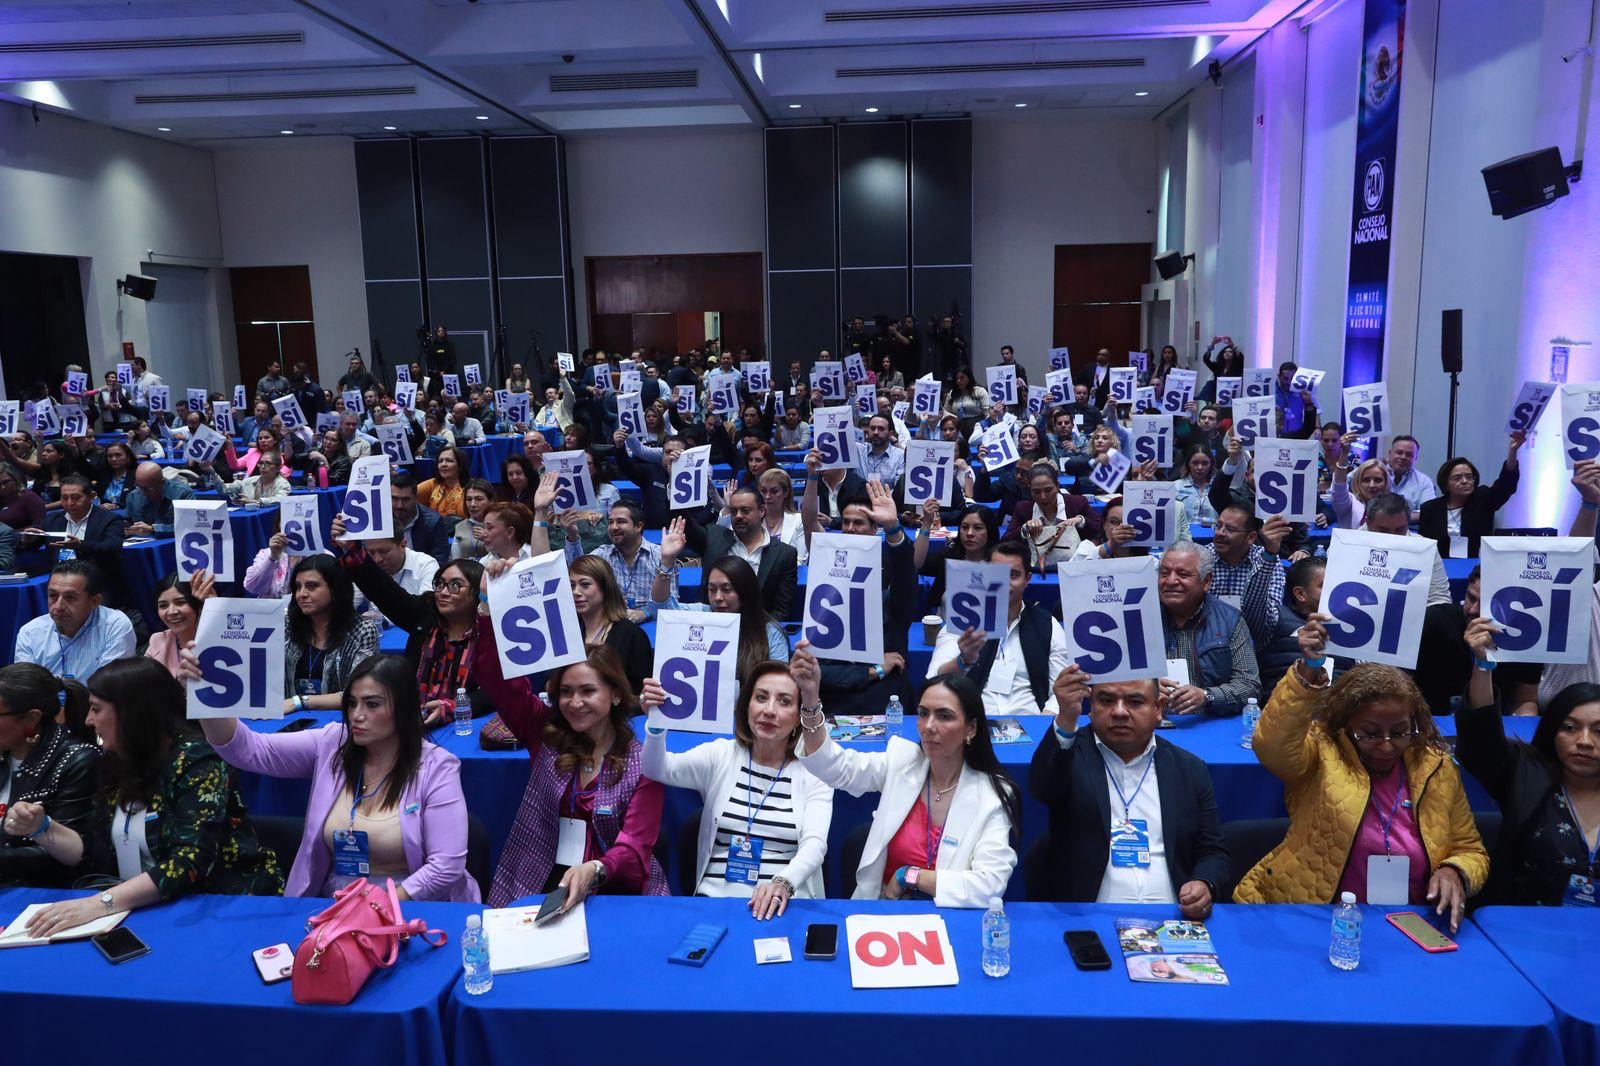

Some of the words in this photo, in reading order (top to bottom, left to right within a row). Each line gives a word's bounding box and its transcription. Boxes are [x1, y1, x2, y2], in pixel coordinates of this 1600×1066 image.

[1358, 214, 1386, 231] CONSEJO
[1354, 225, 1389, 245] NACIONAL
[560, 358, 571, 370] SÍ
[849, 361, 863, 380] SÍ
[1052, 353, 1066, 369] SÍ
[1131, 358, 1144, 371] SÍ
[69, 379, 83, 393] SÍ
[118, 369, 130, 384] SÍ
[398, 369, 409, 382] SÍ
[467, 369, 478, 383] SÍ
[596, 370, 609, 389] SÍ
[750, 369, 768, 389] SÍ
[819, 371, 839, 396] SÍ
[1293, 375, 1316, 390] SÍ
[234, 391, 244, 407] Í
[397, 389, 414, 408] SÍ
[446, 380, 458, 395] SÍ
[713, 383, 734, 410] SÍ
[990, 375, 1012, 401] SÍ
[1051, 377, 1070, 402] SÍ
[1112, 376, 1133, 400] SÍ
[1165, 386, 1192, 411] SÍ
[151, 392, 167, 410] SÍ
[190, 395, 204, 410] SÍ
[346, 396, 361, 412] SÍ
[508, 400, 526, 423] SÍ
[677, 391, 692, 410] SÍ
[860, 391, 874, 412] SÍ
[916, 389, 937, 412] SÍ
[37, 407, 55, 430] SÍ
[64, 411, 83, 434] SÍ
[216, 410, 231, 431] SÍ
[281, 402, 303, 427] SÍ
[620, 403, 642, 434] SÍ
[894, 408, 907, 419] SÍ
[1350, 396, 1382, 434] SÍ
[1510, 396, 1548, 430] SÍ
[1237, 409, 1270, 446] SÍ
[1567, 417, 1600, 461] S
[189, 439, 219, 461] SÍ
[383, 434, 407, 462] SÍ
[817, 421, 850, 464] SÍ
[987, 432, 1012, 465] SÍ
[1136, 428, 1168, 464] SÍ
[554, 465, 587, 508] SÍ
[674, 458, 704, 503] SÍ
[909, 457, 949, 499] SÍ
[1258, 460, 1312, 514] SÍ
[343, 474, 384, 533] SÍ
[285, 510, 316, 551] SÍ
[1127, 498, 1170, 541] SÍ
[181, 520, 224, 574] SÍ
[1359, 570, 1392, 579] NACIONAL
[1519, 573, 1553, 581] NACIONAL
[517, 590, 542, 599] NACIONAL
[518, 586, 538, 594] CONSEJO
[806, 567, 873, 651] SÍ
[951, 583, 1003, 631] SÍ
[1325, 568, 1421, 654] SÍ
[1491, 567, 1583, 652] SÍ
[501, 578, 568, 665] SÍ
[1073, 587, 1148, 674] SÍ
[195, 628, 275, 708] SÍ
[659, 641, 729, 720] SÍ
